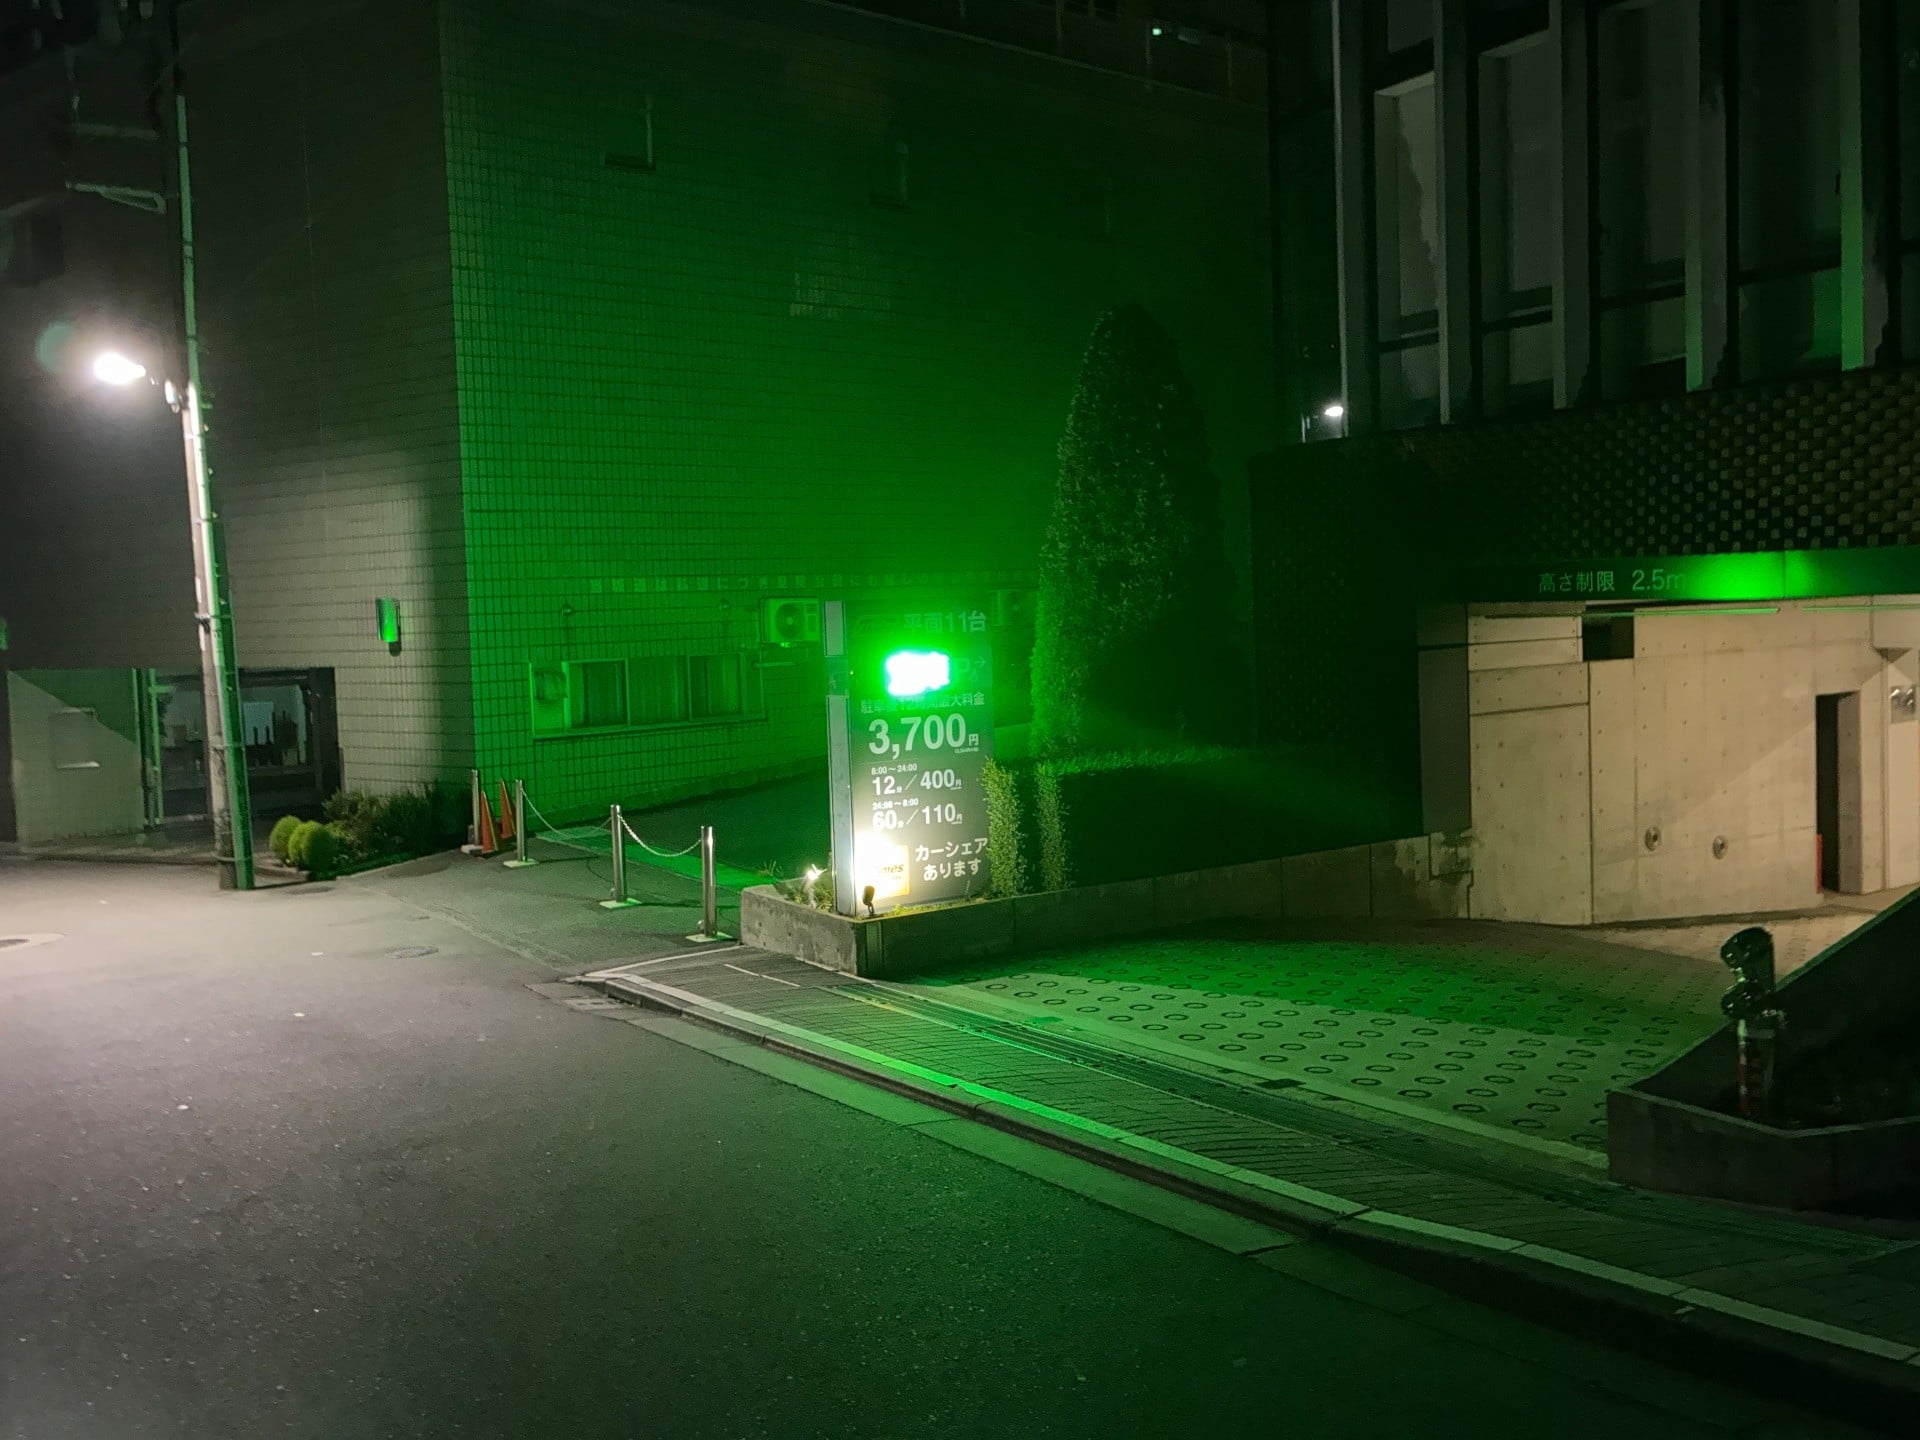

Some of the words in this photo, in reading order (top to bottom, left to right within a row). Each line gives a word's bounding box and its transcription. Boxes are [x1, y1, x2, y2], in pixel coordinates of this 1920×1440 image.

[1539, 570, 1615, 592] 高さ制限
[1632, 569, 1685, 591] 2.5m
[904, 610, 986, 632] 平面11台
[869, 713, 979, 759] 3,700円
[915, 837, 989, 862] カーシェア
[923, 859, 982, 882] あります
